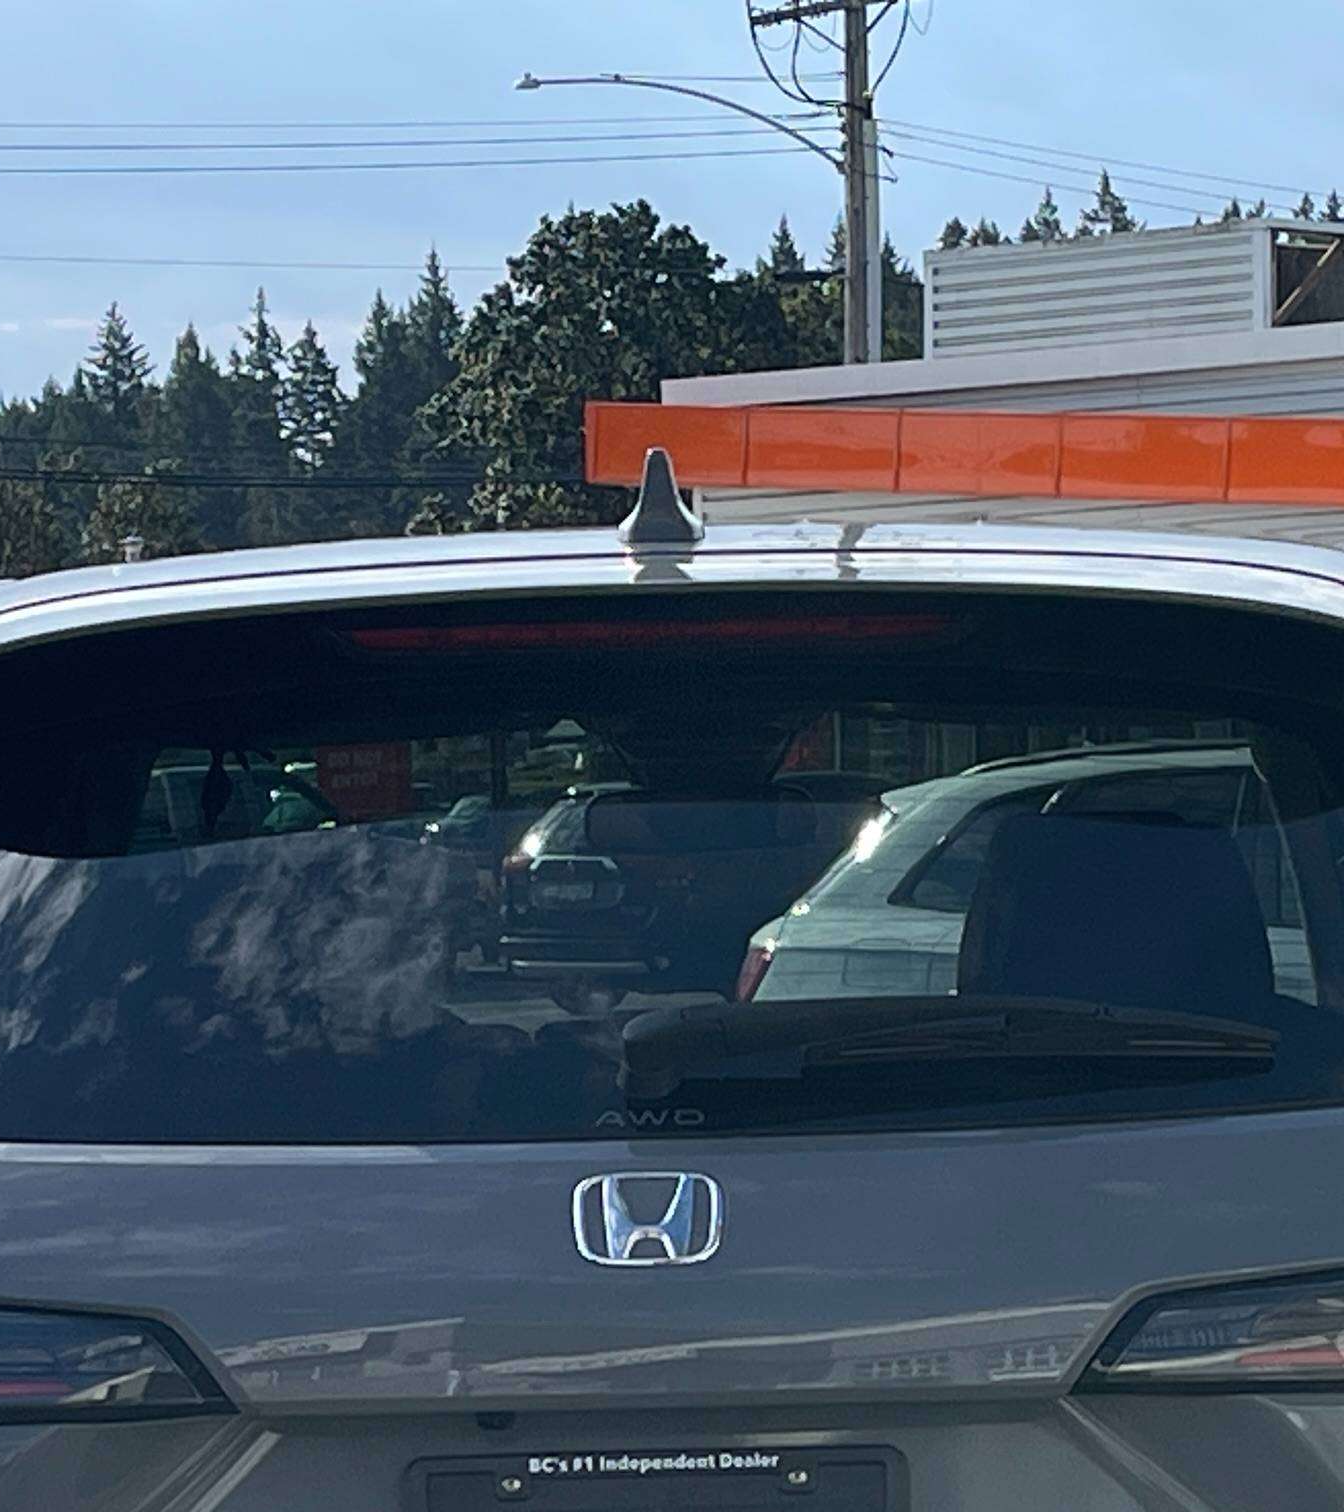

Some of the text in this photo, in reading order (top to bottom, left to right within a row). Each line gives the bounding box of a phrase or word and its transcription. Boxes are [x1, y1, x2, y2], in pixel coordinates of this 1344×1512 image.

[595, 1108, 705, 1128] AWD
[599, 1453, 716, 1475] Independent
[719, 1452, 780, 1470] Dealer
